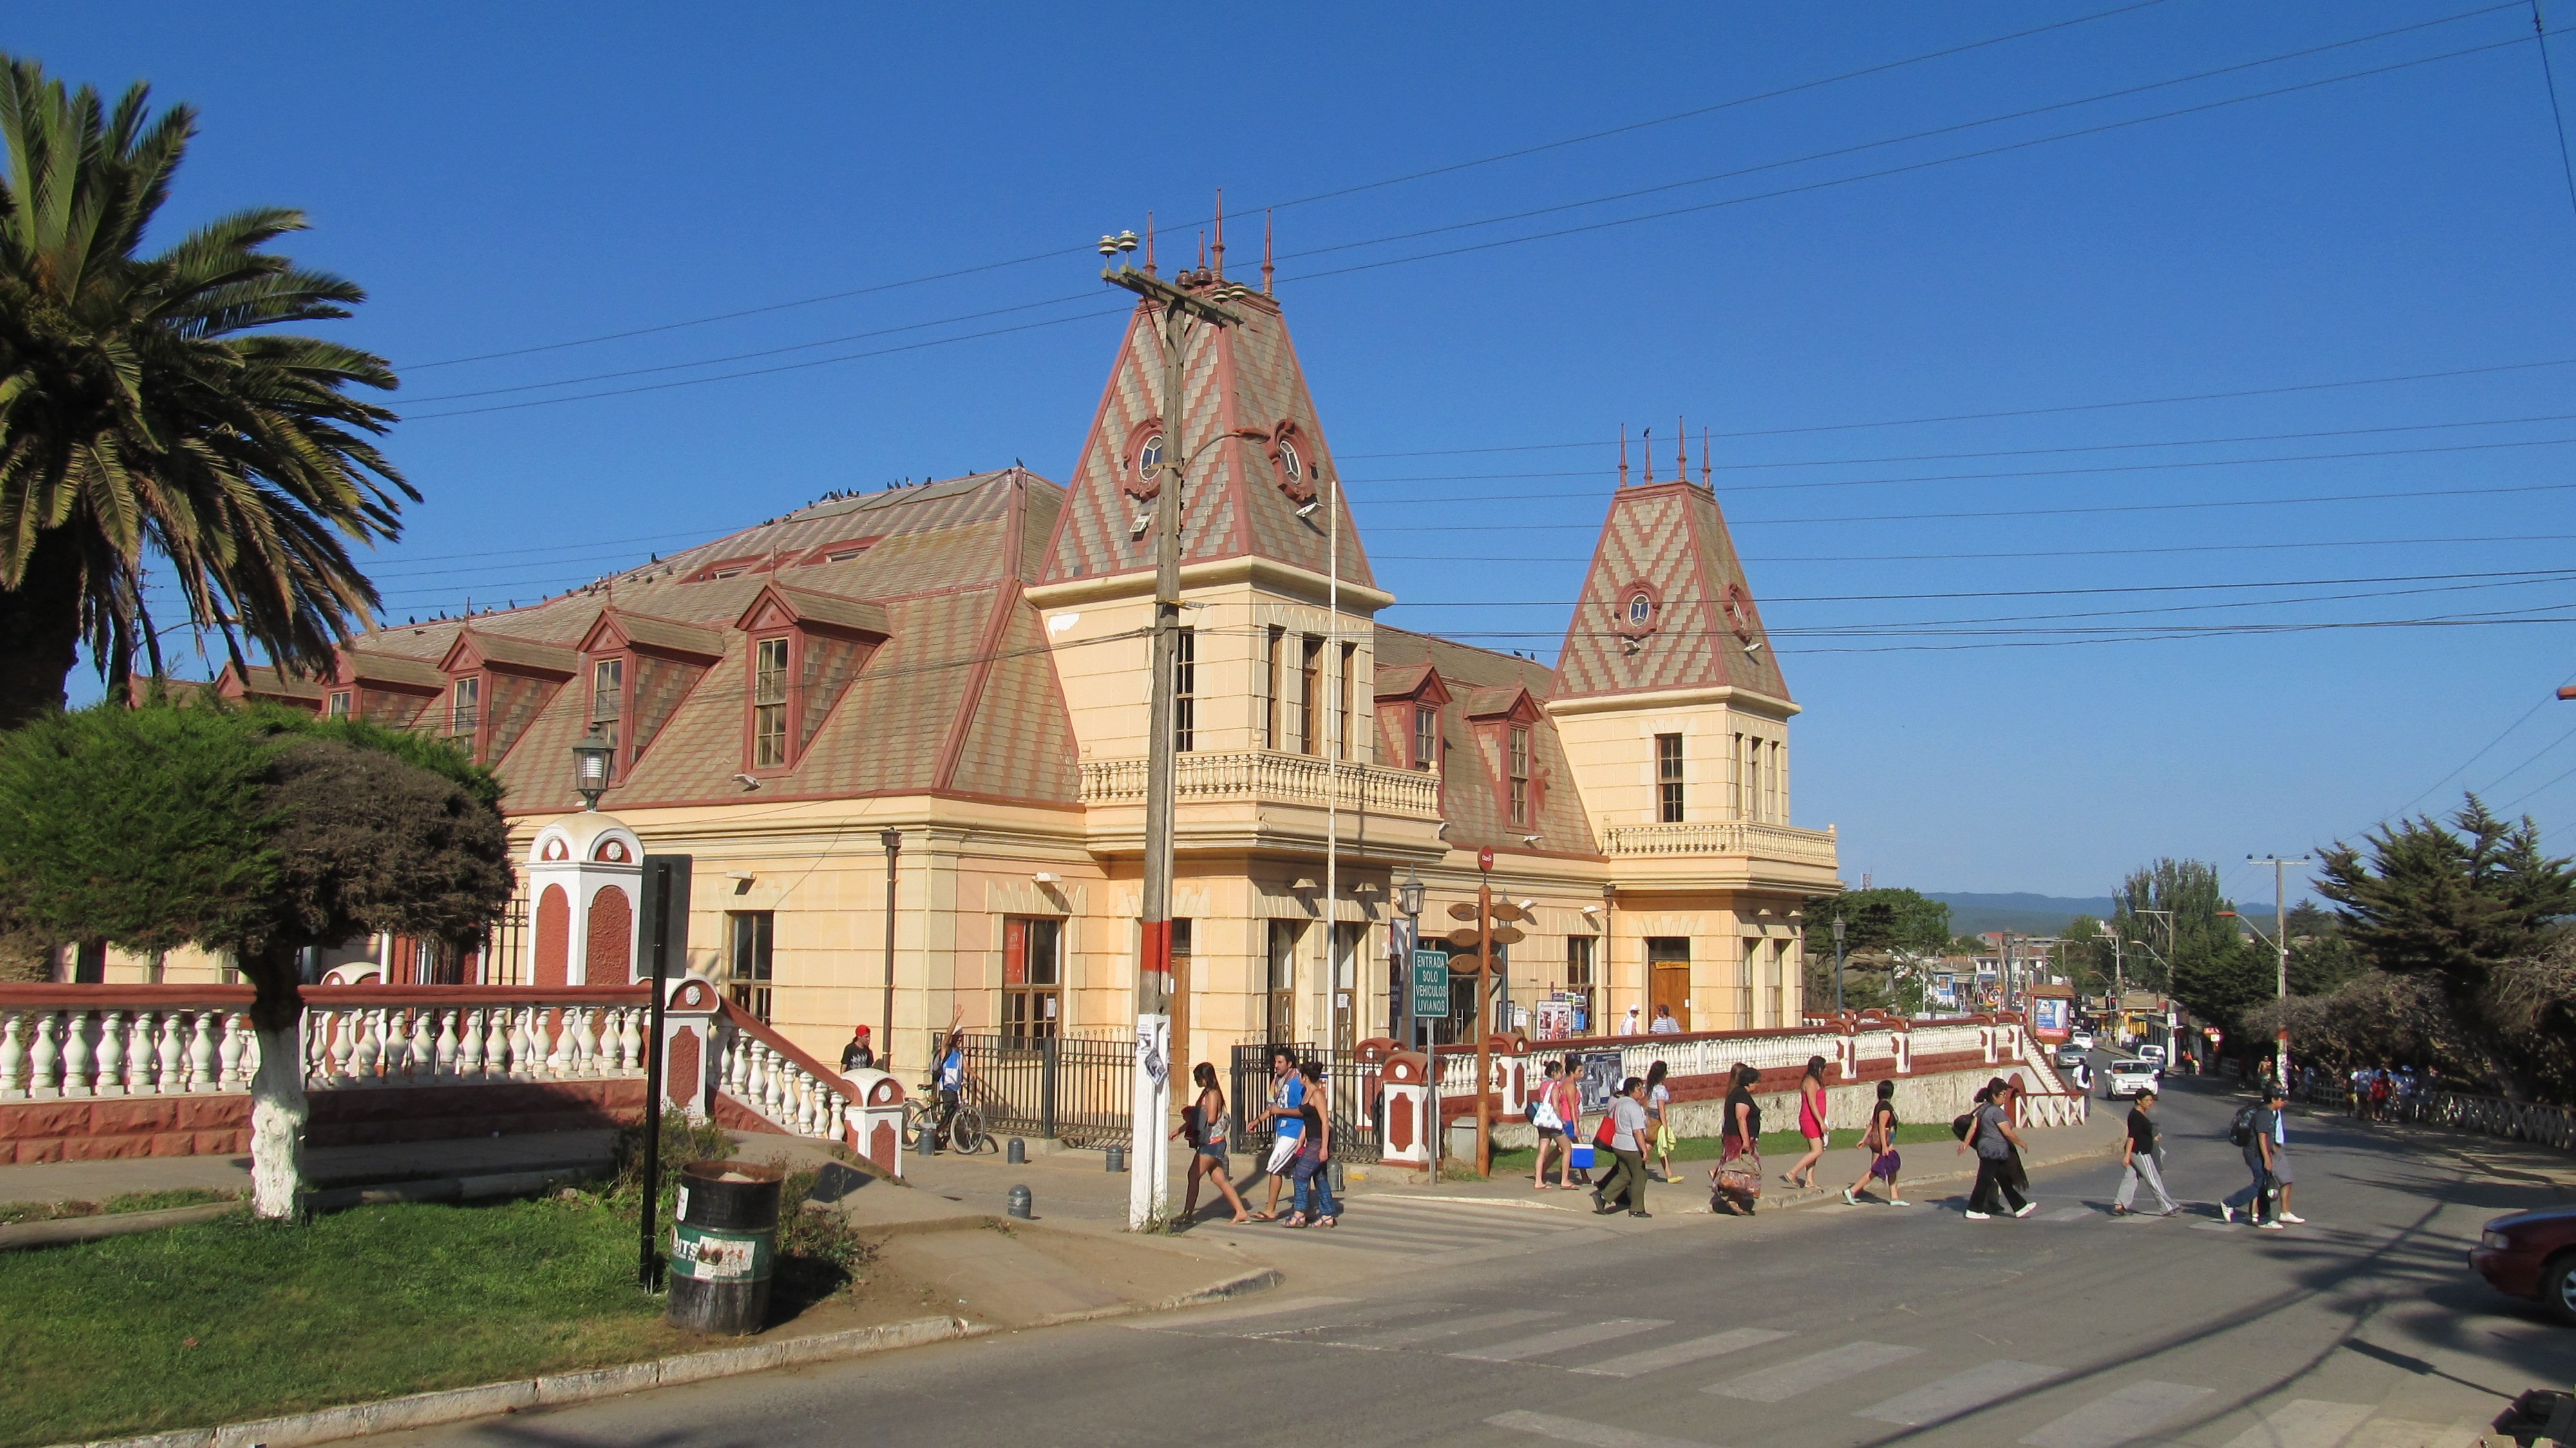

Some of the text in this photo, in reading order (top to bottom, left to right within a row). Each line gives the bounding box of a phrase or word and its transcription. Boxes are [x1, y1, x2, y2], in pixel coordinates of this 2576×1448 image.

[1417, 955, 1444, 968] ENTRADA
[1422, 970, 1438, 982] SOLO
[1416, 985, 1446, 997] VEHICULOS
[1417, 1000, 1445, 1011] LIVIANOS
